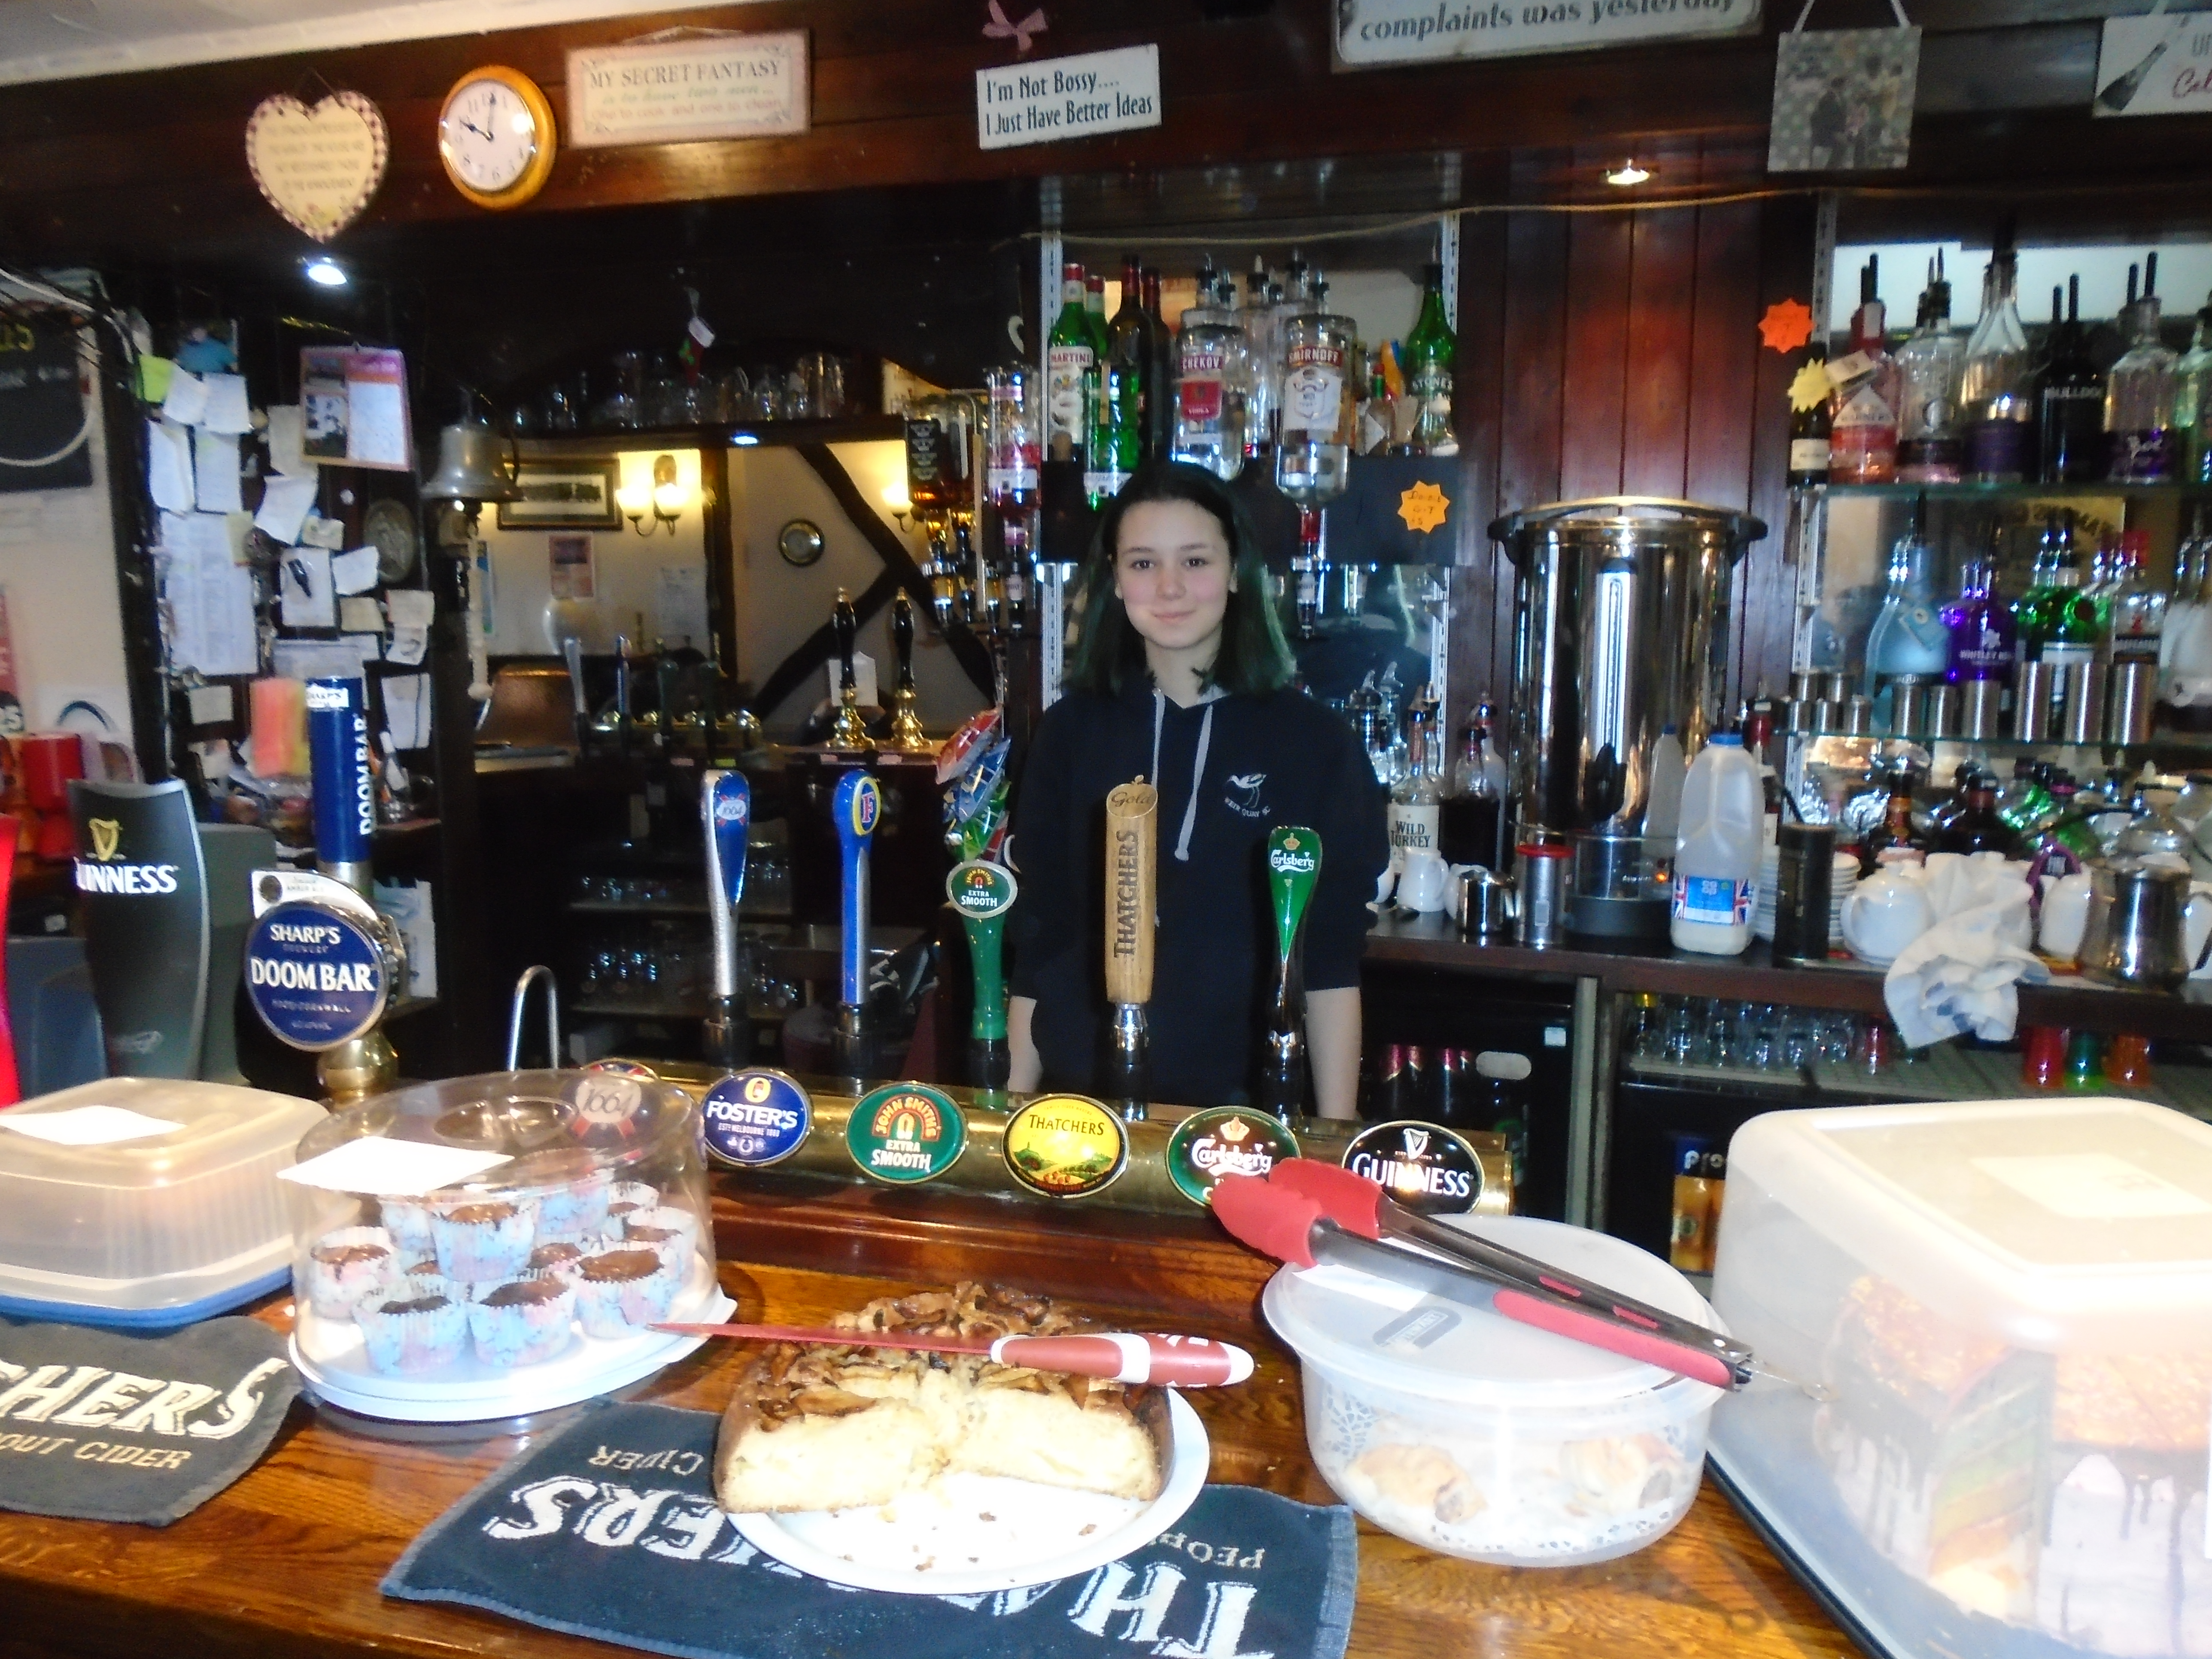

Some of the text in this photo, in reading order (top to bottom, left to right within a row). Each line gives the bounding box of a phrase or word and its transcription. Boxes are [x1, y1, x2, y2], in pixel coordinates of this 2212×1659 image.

[1360, 0, 1734, 41] complaints was yestery
[590, 59, 781, 88] MY SECRET FANTASY
[987, 80, 1013, 103] I'm
[1019, 75, 1048, 98] Not
[987, 91, 1152, 137] I Just Have Better Ideas
[1051, 352, 1091, 363] MARTINI
[1182, 356, 1220, 370] CHEKOV
[1288, 348, 1340, 363] SMIRNOFF
[353, 717, 372, 836] DOOM BAR
[861, 791, 875, 823] F
[1111, 791, 1151, 807] Gold
[1391, 830, 1431, 848] TURKEY
[1395, 820, 1425, 835] WILD
[1270, 849, 1315, 872] Carlsberg
[966, 870, 977, 884] JOHN
[961, 895, 998, 907] SMOOTH
[1114, 830, 1140, 958] THATCHERS
[270, 923, 341, 945] SHARP'S
[250, 956, 376, 991] DOOM BAR
[706, 1100, 799, 1129] FOSTER'S
[875, 1096, 942, 1138] JOHN SMITH'S
[1029, 1114, 1105, 1136] THATCHERS
[885, 1139, 921, 1152] EXTRA
[1191, 1138, 1273, 1175] Carlsberg
[871, 1149, 932, 1171] SMOOTH
[1353, 1153, 1471, 1197] GUINNESS
[73, 1441, 193, 1470] CIDER
[589, 1444, 705, 1476] CIDER
[1146, 1531, 1265, 1570] PEOP
